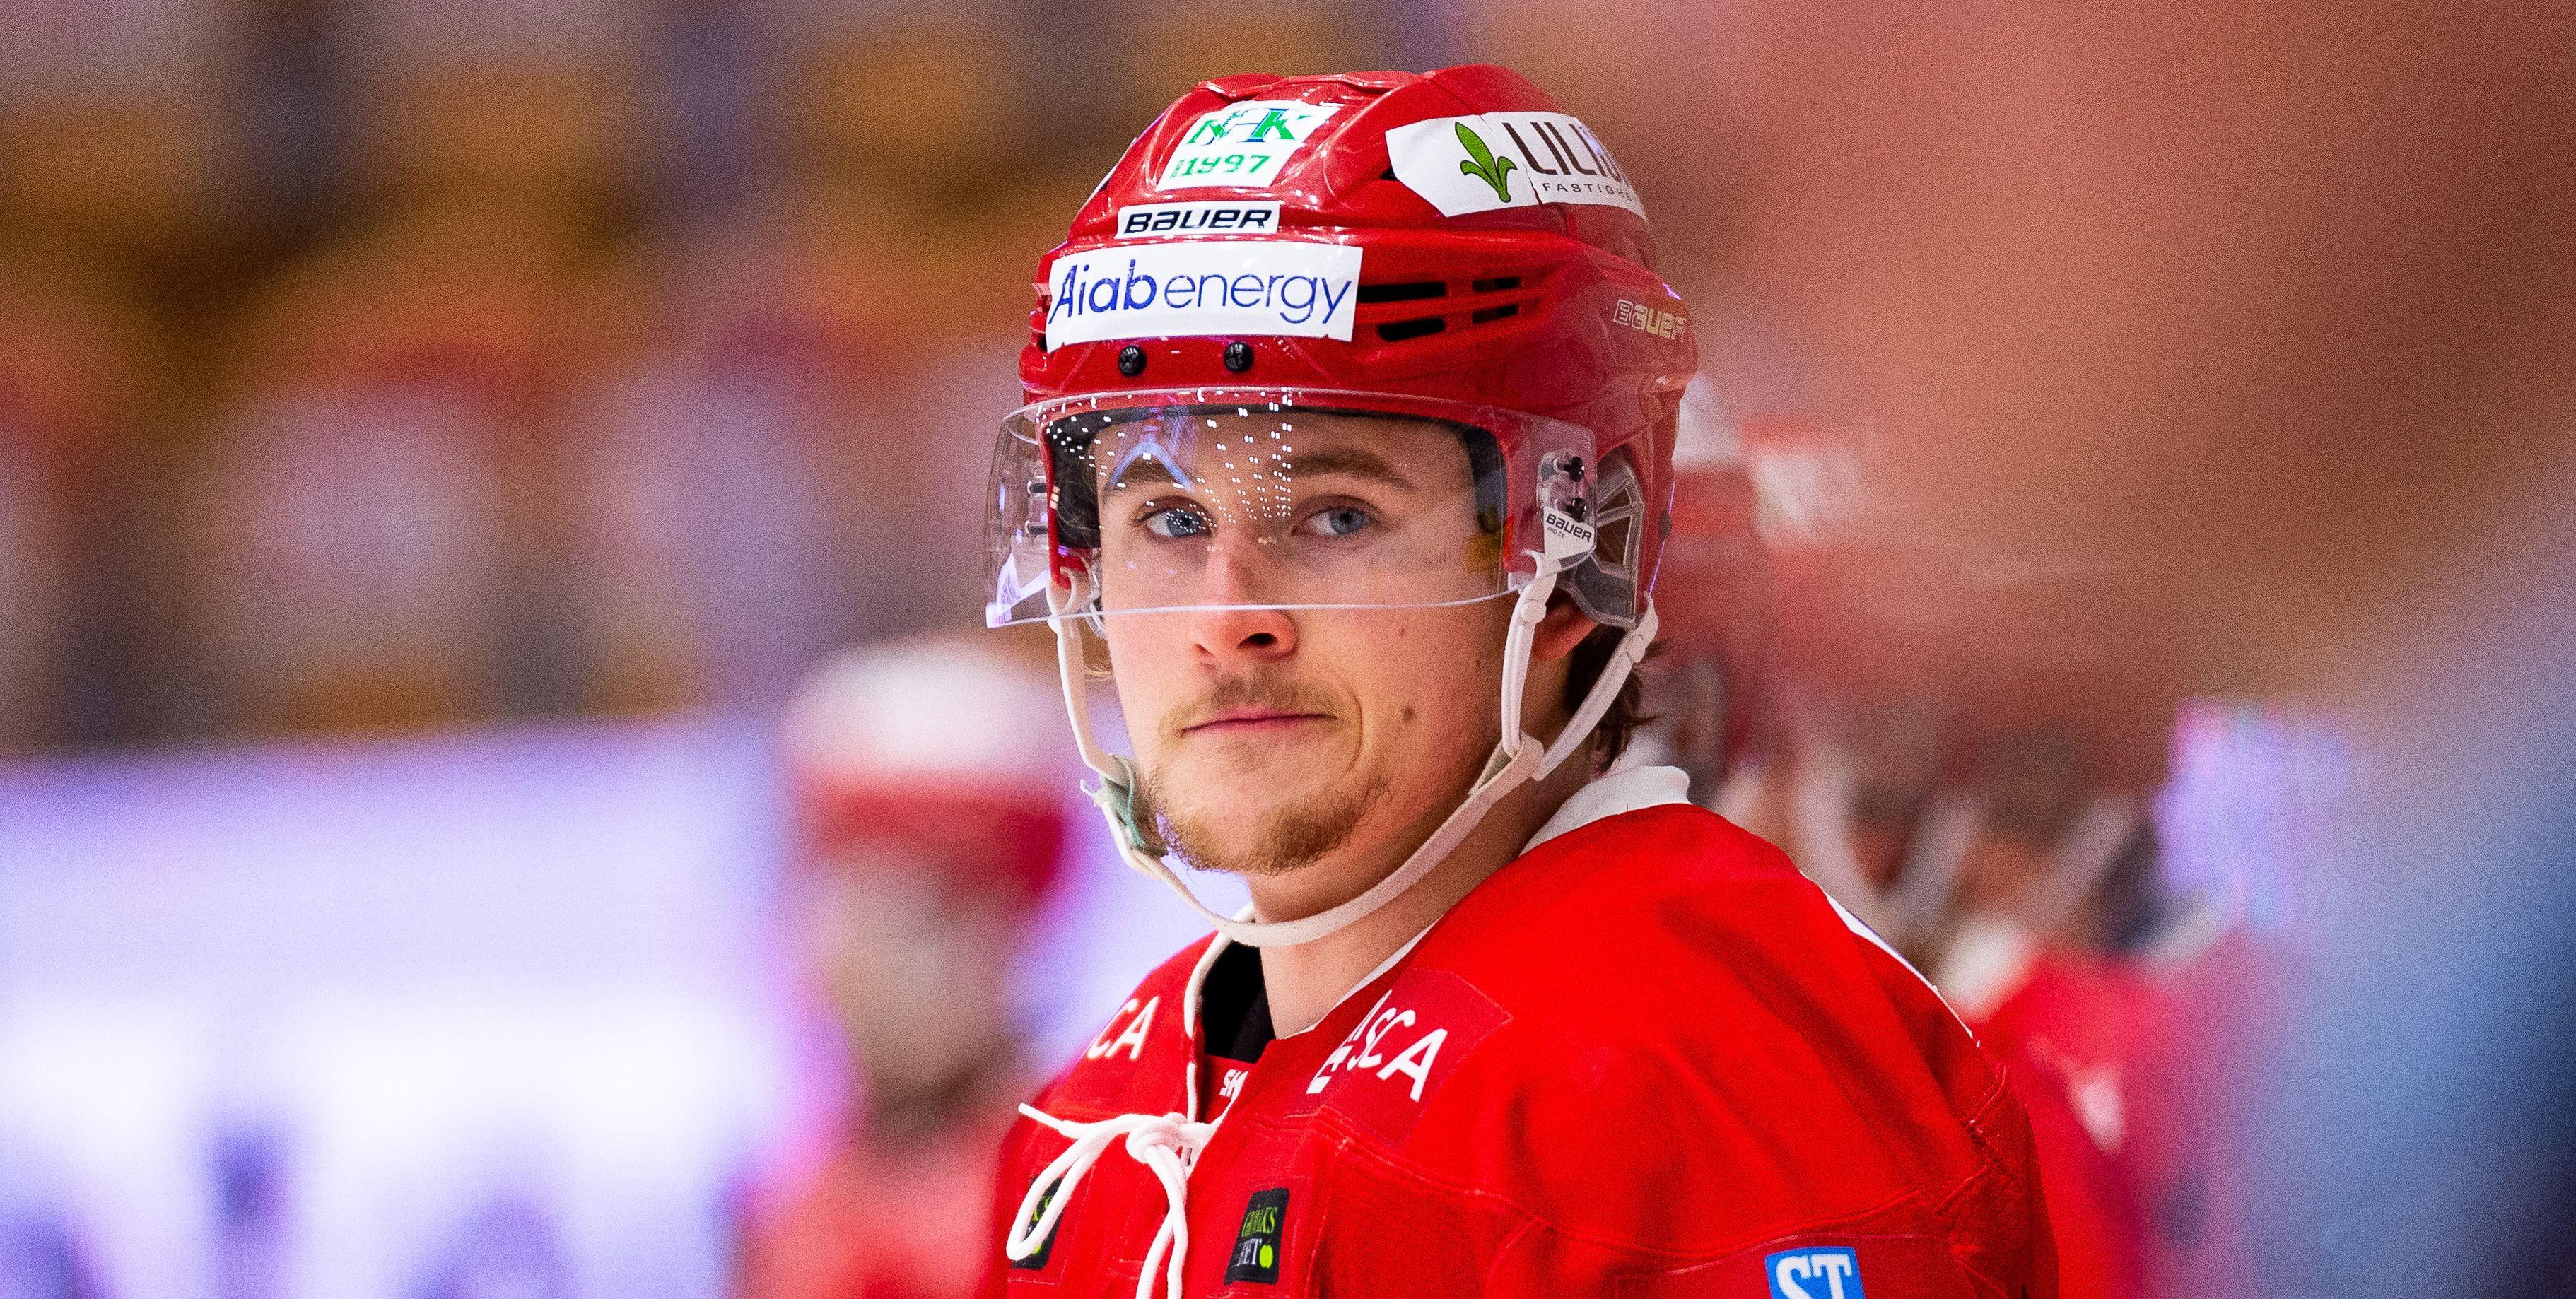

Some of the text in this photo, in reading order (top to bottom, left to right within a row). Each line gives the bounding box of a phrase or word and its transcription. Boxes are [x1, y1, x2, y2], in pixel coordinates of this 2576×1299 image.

[1180, 153, 1272, 176] 1997
[1123, 208, 1273, 235] BAUER
[1612, 298, 1687, 340] BAUER
[1545, 513, 1593, 543] BAUER
